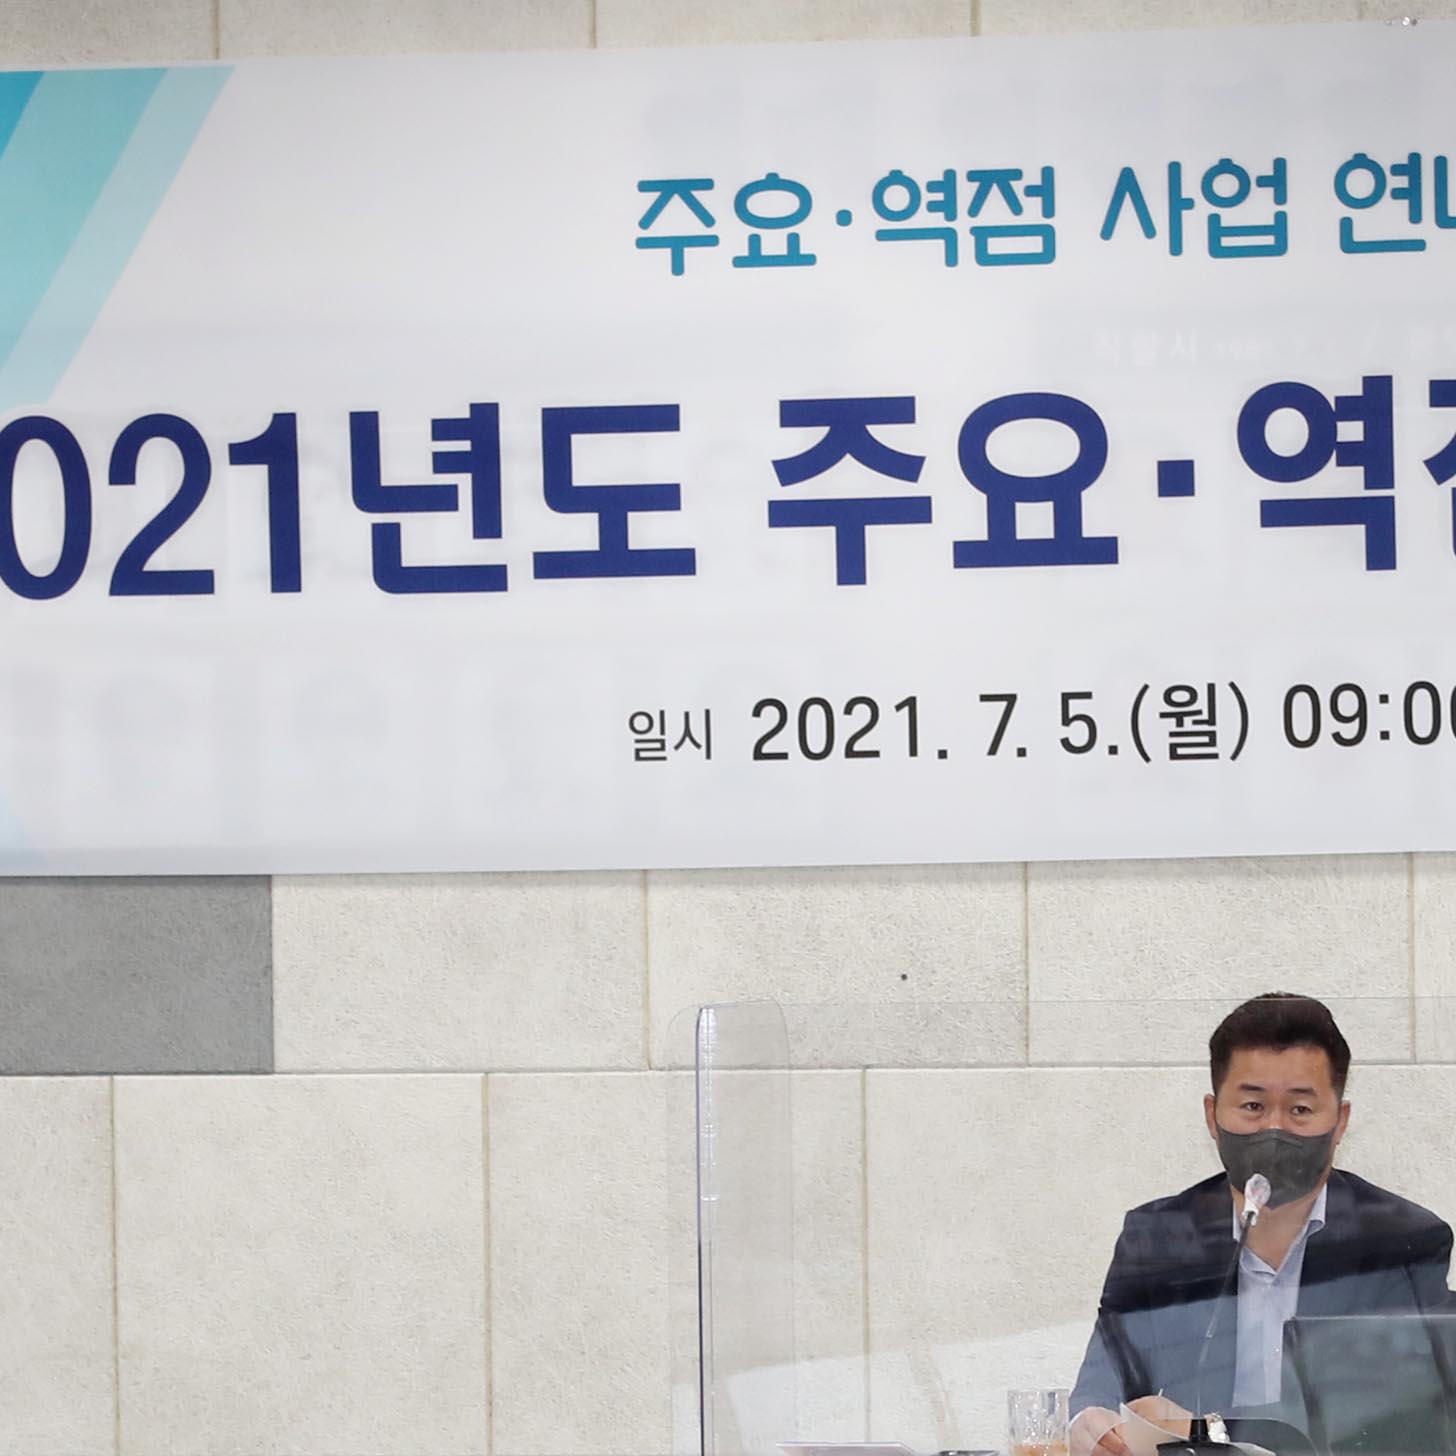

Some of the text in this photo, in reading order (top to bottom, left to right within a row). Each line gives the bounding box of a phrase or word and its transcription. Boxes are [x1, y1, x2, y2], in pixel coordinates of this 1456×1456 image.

[634, 164, 1058, 278] 주요·역점
[1098, 155, 1290, 260] 사업
[627, 707, 713, 763] 일시
[750, 694, 949, 763] 2021.
[977, 692, 1028, 759] 7.
[1058, 680, 1250, 765] 5.(월)
